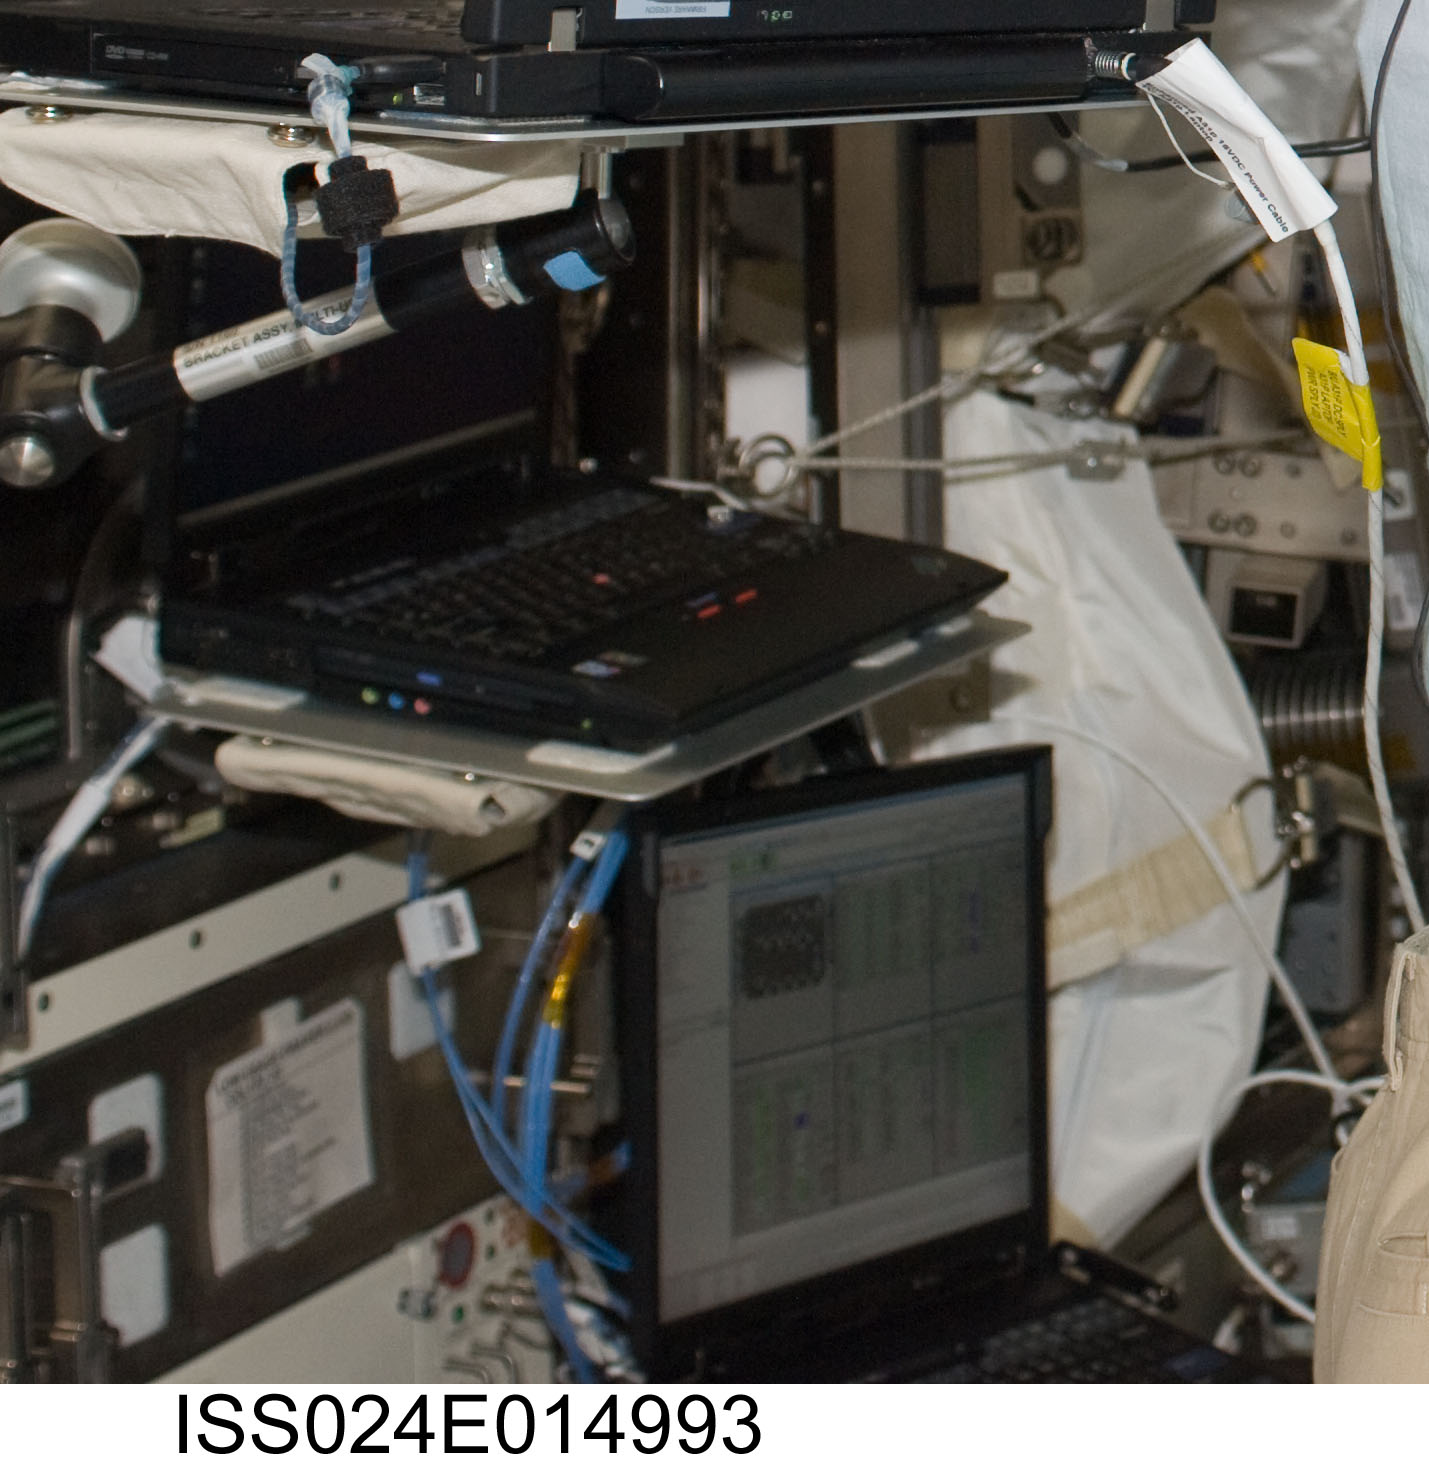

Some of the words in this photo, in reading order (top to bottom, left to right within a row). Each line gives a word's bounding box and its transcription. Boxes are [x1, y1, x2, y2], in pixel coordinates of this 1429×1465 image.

[1243, 171, 1268, 203] Power
[1266, 203, 1289, 234] Cable
[182, 336, 249, 368] BRACKET
